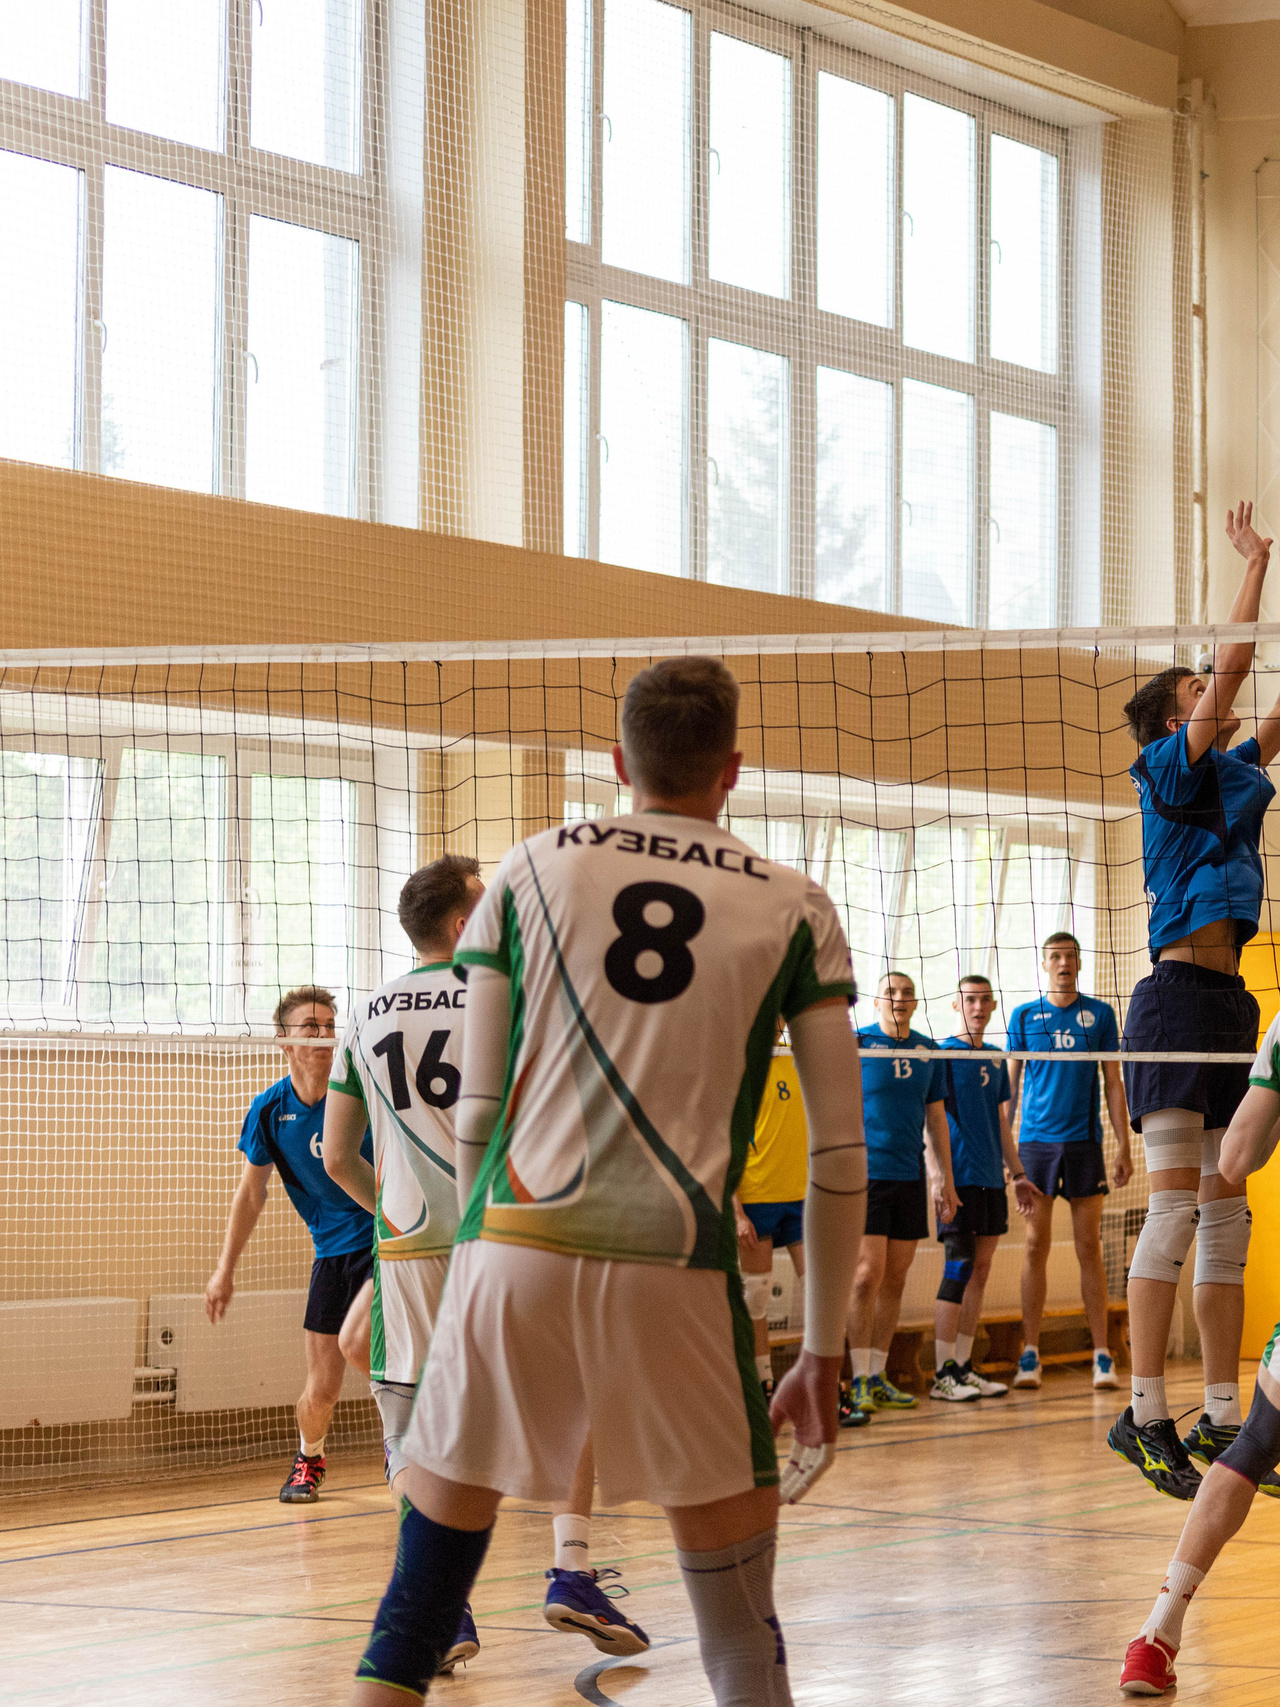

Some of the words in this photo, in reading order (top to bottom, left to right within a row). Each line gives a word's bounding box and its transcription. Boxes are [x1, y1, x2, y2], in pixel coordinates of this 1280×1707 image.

[556, 823, 771, 882] КУЗБАСС
[604, 880, 706, 1006] 8
[367, 989, 468, 1020] КУЗБАС
[1053, 1029, 1076, 1049] 16
[371, 1029, 462, 1111] 16
[892, 1058, 913, 1079] 13
[980, 1065, 990, 1087] 5
[776, 1080, 791, 1101] 8
[309, 1131, 324, 1159] 6
